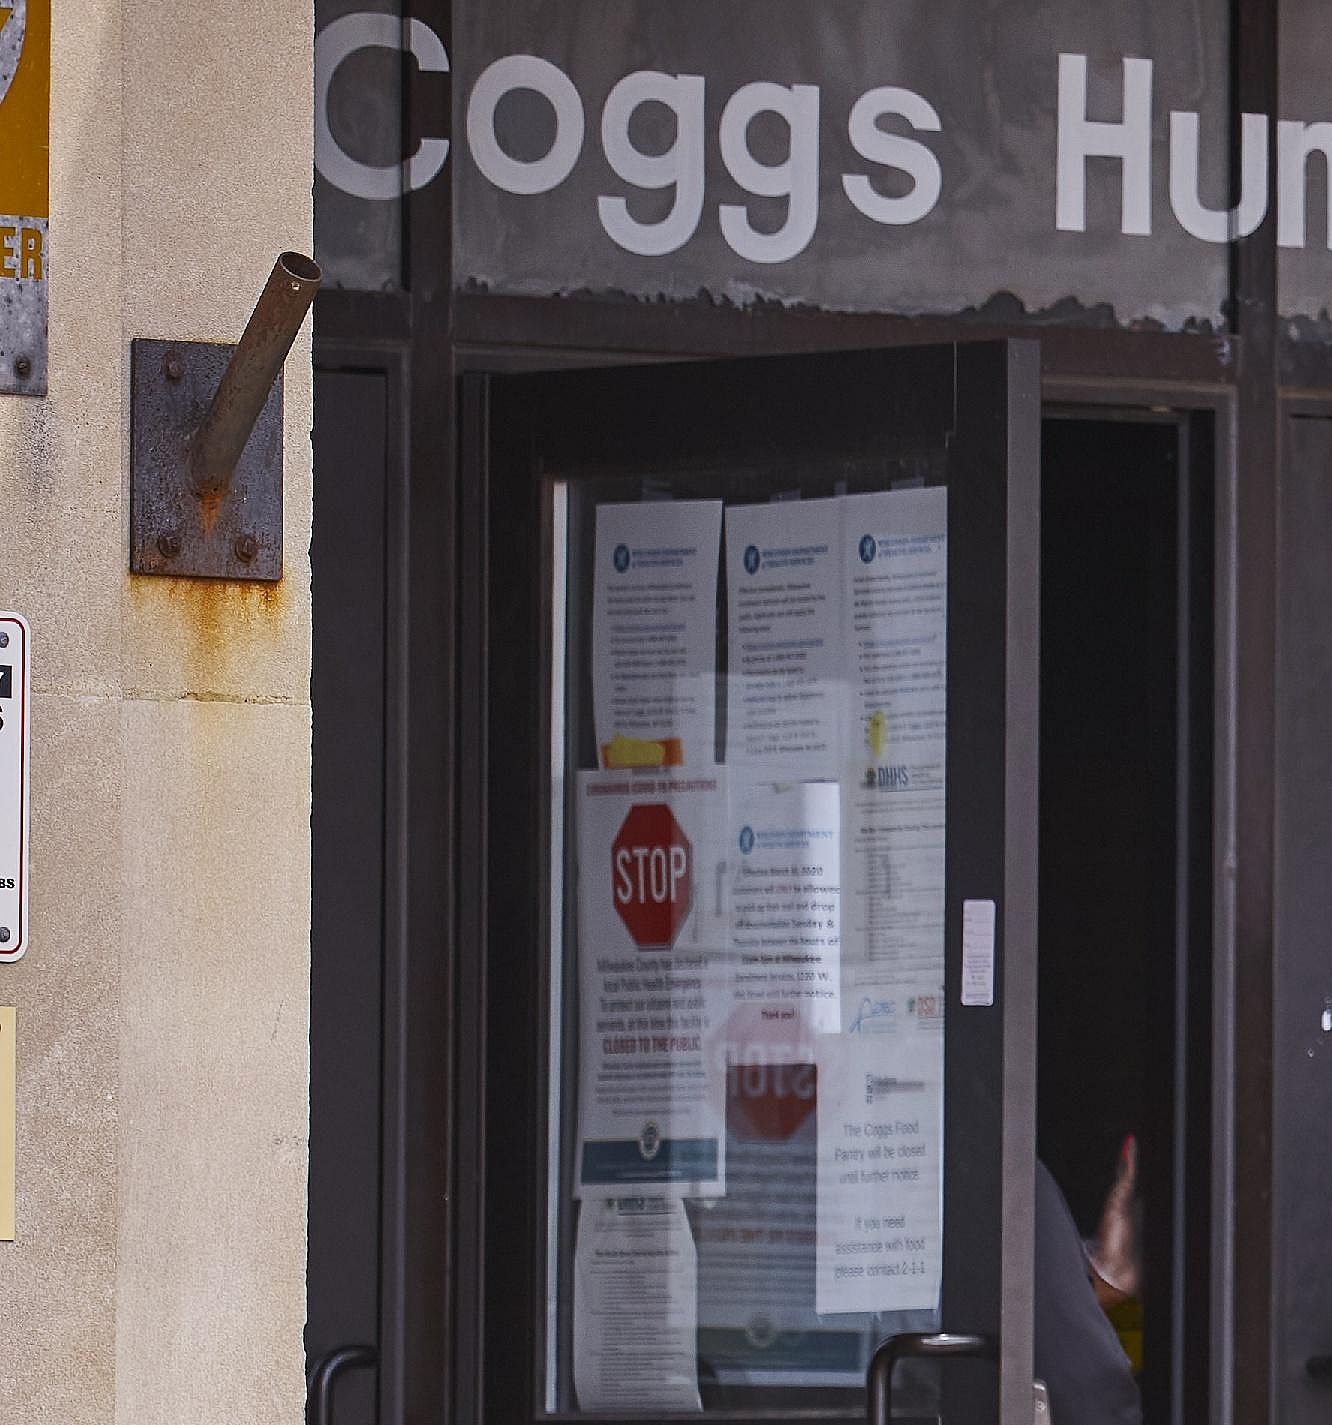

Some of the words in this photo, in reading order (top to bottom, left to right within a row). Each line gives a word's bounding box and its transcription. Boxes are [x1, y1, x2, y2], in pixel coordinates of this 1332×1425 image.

[313, 13, 943, 263] Coggs
[878, 767, 910, 787] DHHS
[616, 846, 688, 903] STOP
[844, 1124, 861, 1137] The
[864, 1122, 893, 1139] Coggs
[895, 1120, 919, 1135] Food
